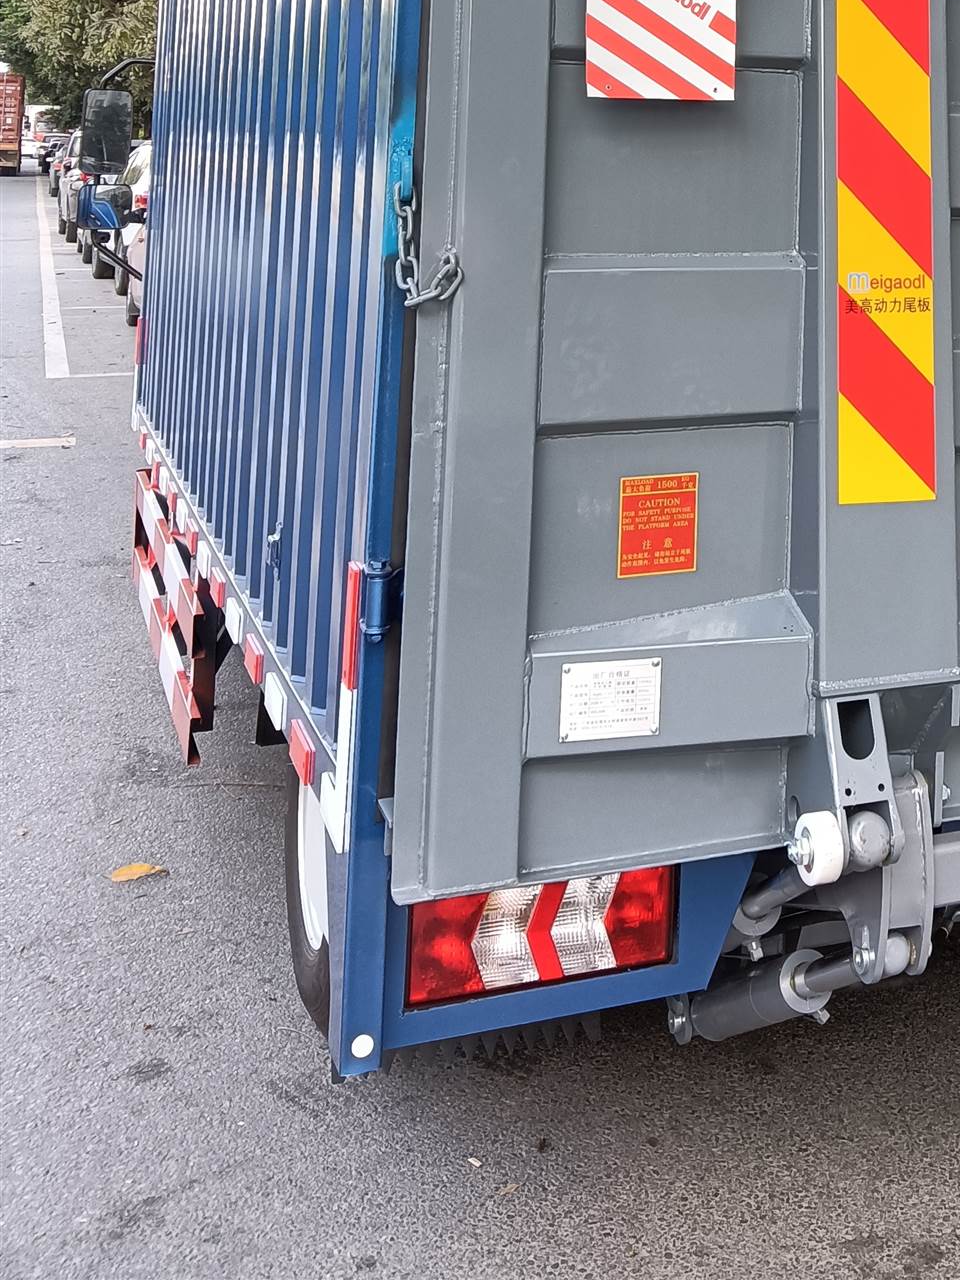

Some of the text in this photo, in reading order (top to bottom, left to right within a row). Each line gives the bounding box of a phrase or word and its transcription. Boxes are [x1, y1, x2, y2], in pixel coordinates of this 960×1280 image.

[845, 297, 931, 314] 美高动力尾板
[657, 480, 678, 489] 1500
[638, 497, 681, 508] CAUTION
